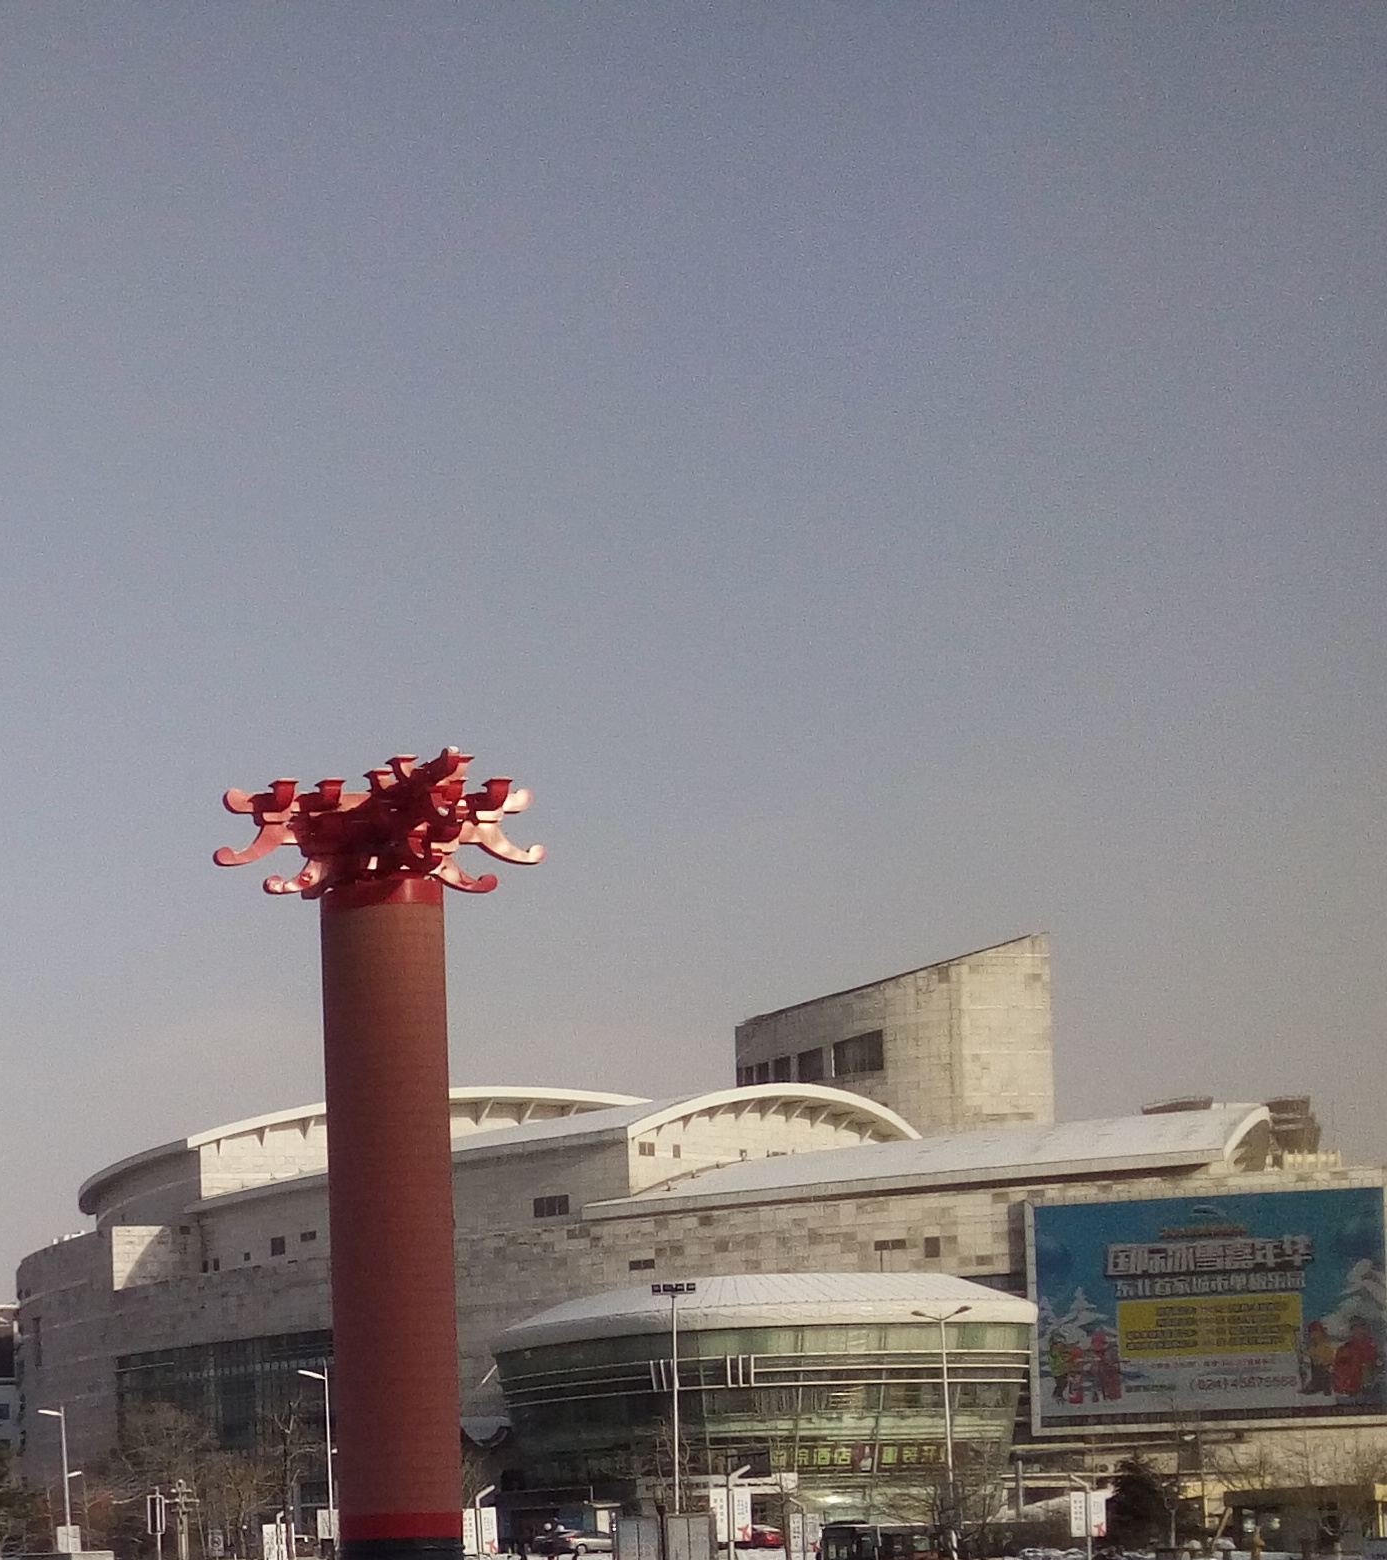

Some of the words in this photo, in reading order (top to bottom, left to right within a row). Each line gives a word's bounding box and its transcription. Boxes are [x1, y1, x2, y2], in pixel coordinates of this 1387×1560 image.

[1105, 1234, 1313, 1276] 国际冰雪嘉年华
